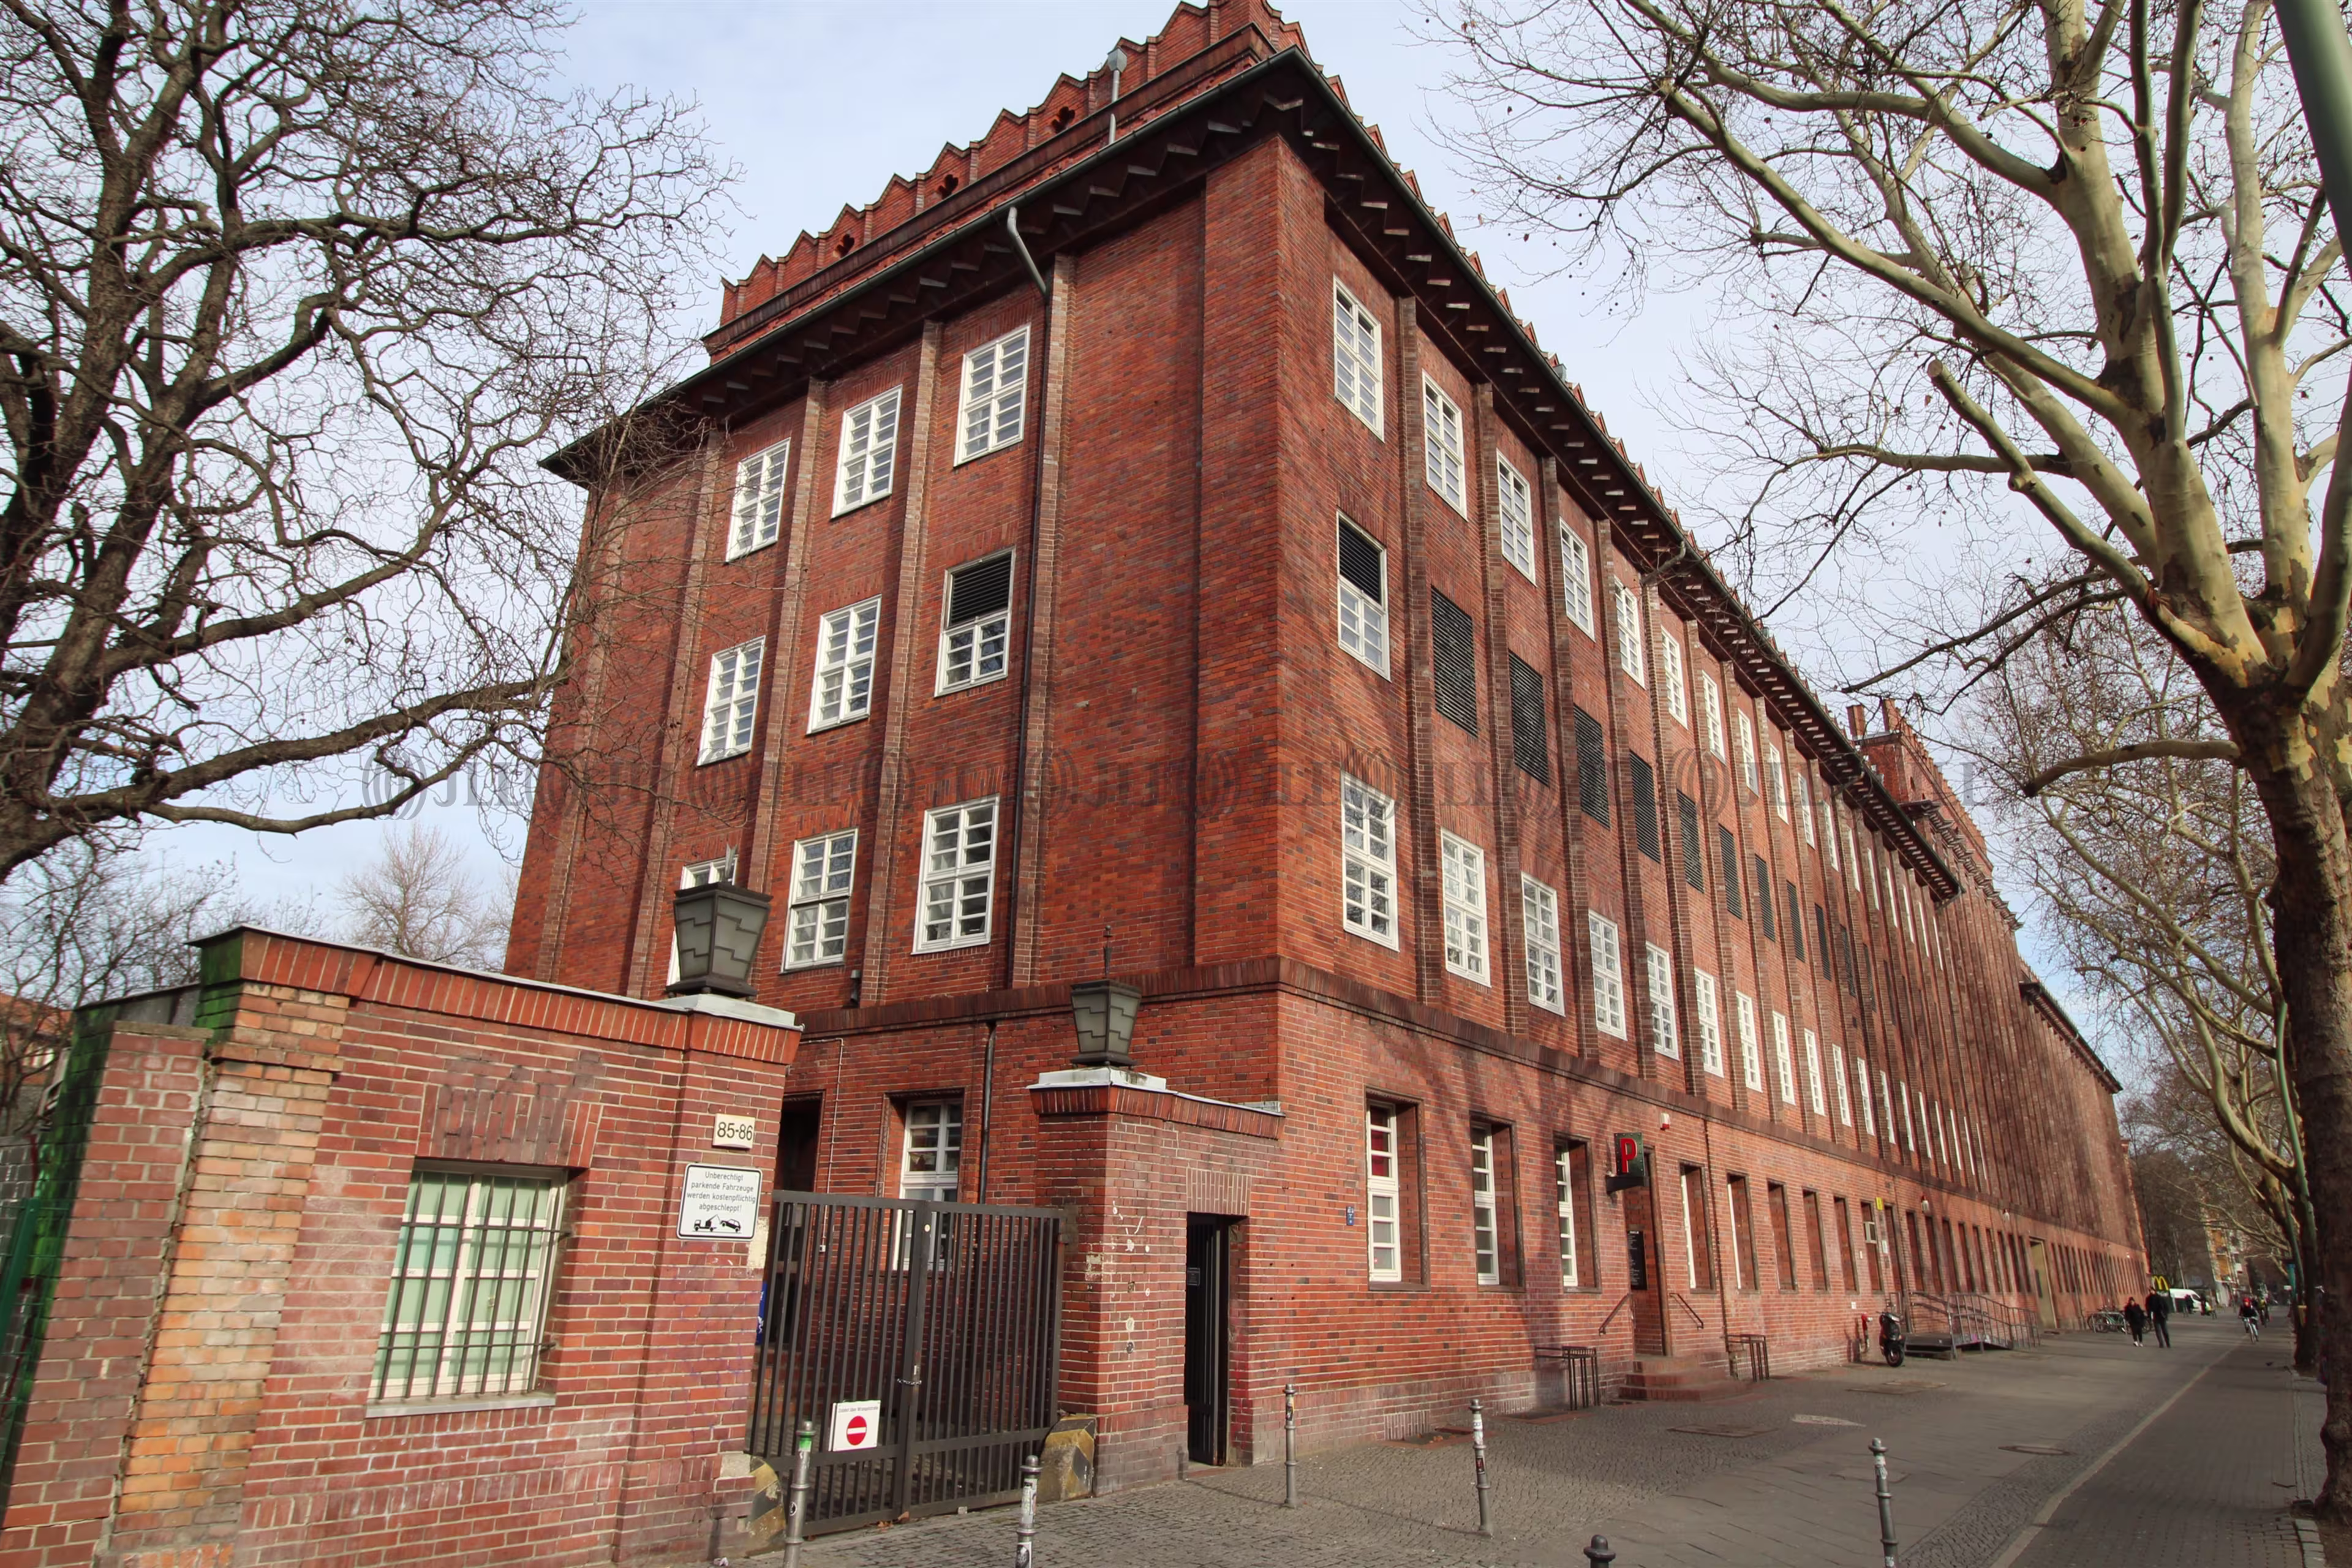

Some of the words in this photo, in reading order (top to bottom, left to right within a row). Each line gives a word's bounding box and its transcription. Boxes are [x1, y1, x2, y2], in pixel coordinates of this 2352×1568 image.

[717, 1121, 753, 1140] 85-86
[1619, 1137, 1637, 1173] P
[705, 1171, 744, 1182] Unberechtigt
[722, 1183, 754, 1193] Fahrzeuge
[712, 1193, 756, 1204] kostenpflichtig
[699, 1202, 742, 1213] abgeschleppt!
